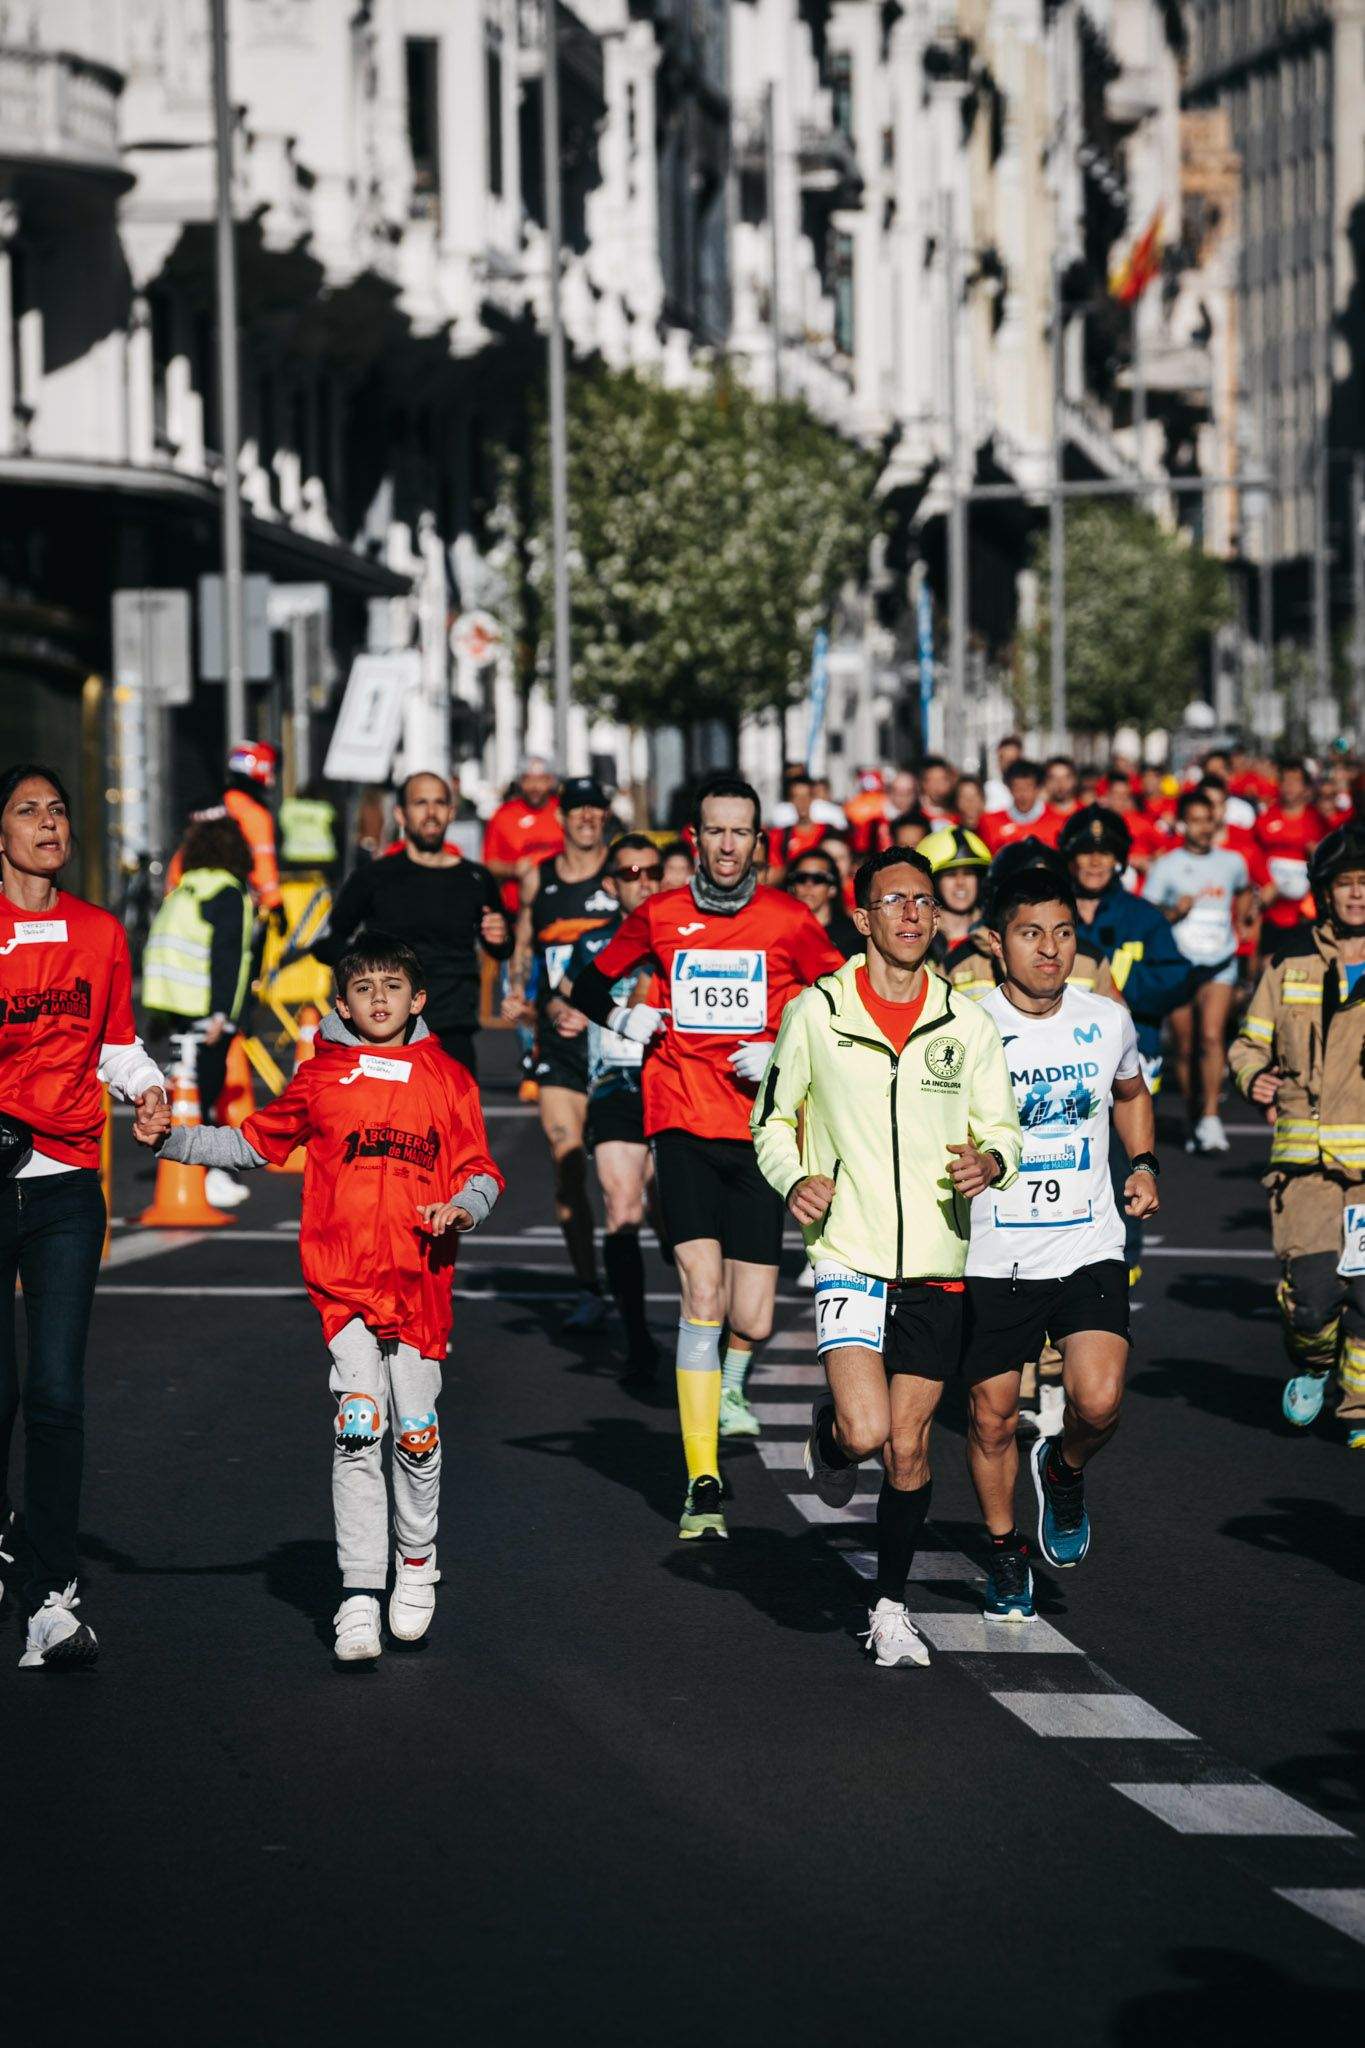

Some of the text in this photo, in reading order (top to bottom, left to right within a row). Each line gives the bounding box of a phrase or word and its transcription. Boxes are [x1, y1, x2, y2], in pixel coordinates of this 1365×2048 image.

[17, 991, 87, 1008] BOEROS
[690, 987, 748, 1007] 1636
[932, 1080, 961, 1088] INCOLORA
[1010, 1062, 1099, 1087] MADRID
[370, 1129, 436, 1156] BOMBEROS
[388, 1143, 433, 1169] de MADRID
[1022, 1152, 1075, 1164] BOMBEROS
[1027, 1179, 1060, 1204] 79
[841, 1281, 866, 1292] MADRID
[818, 1297, 849, 1323] 77
